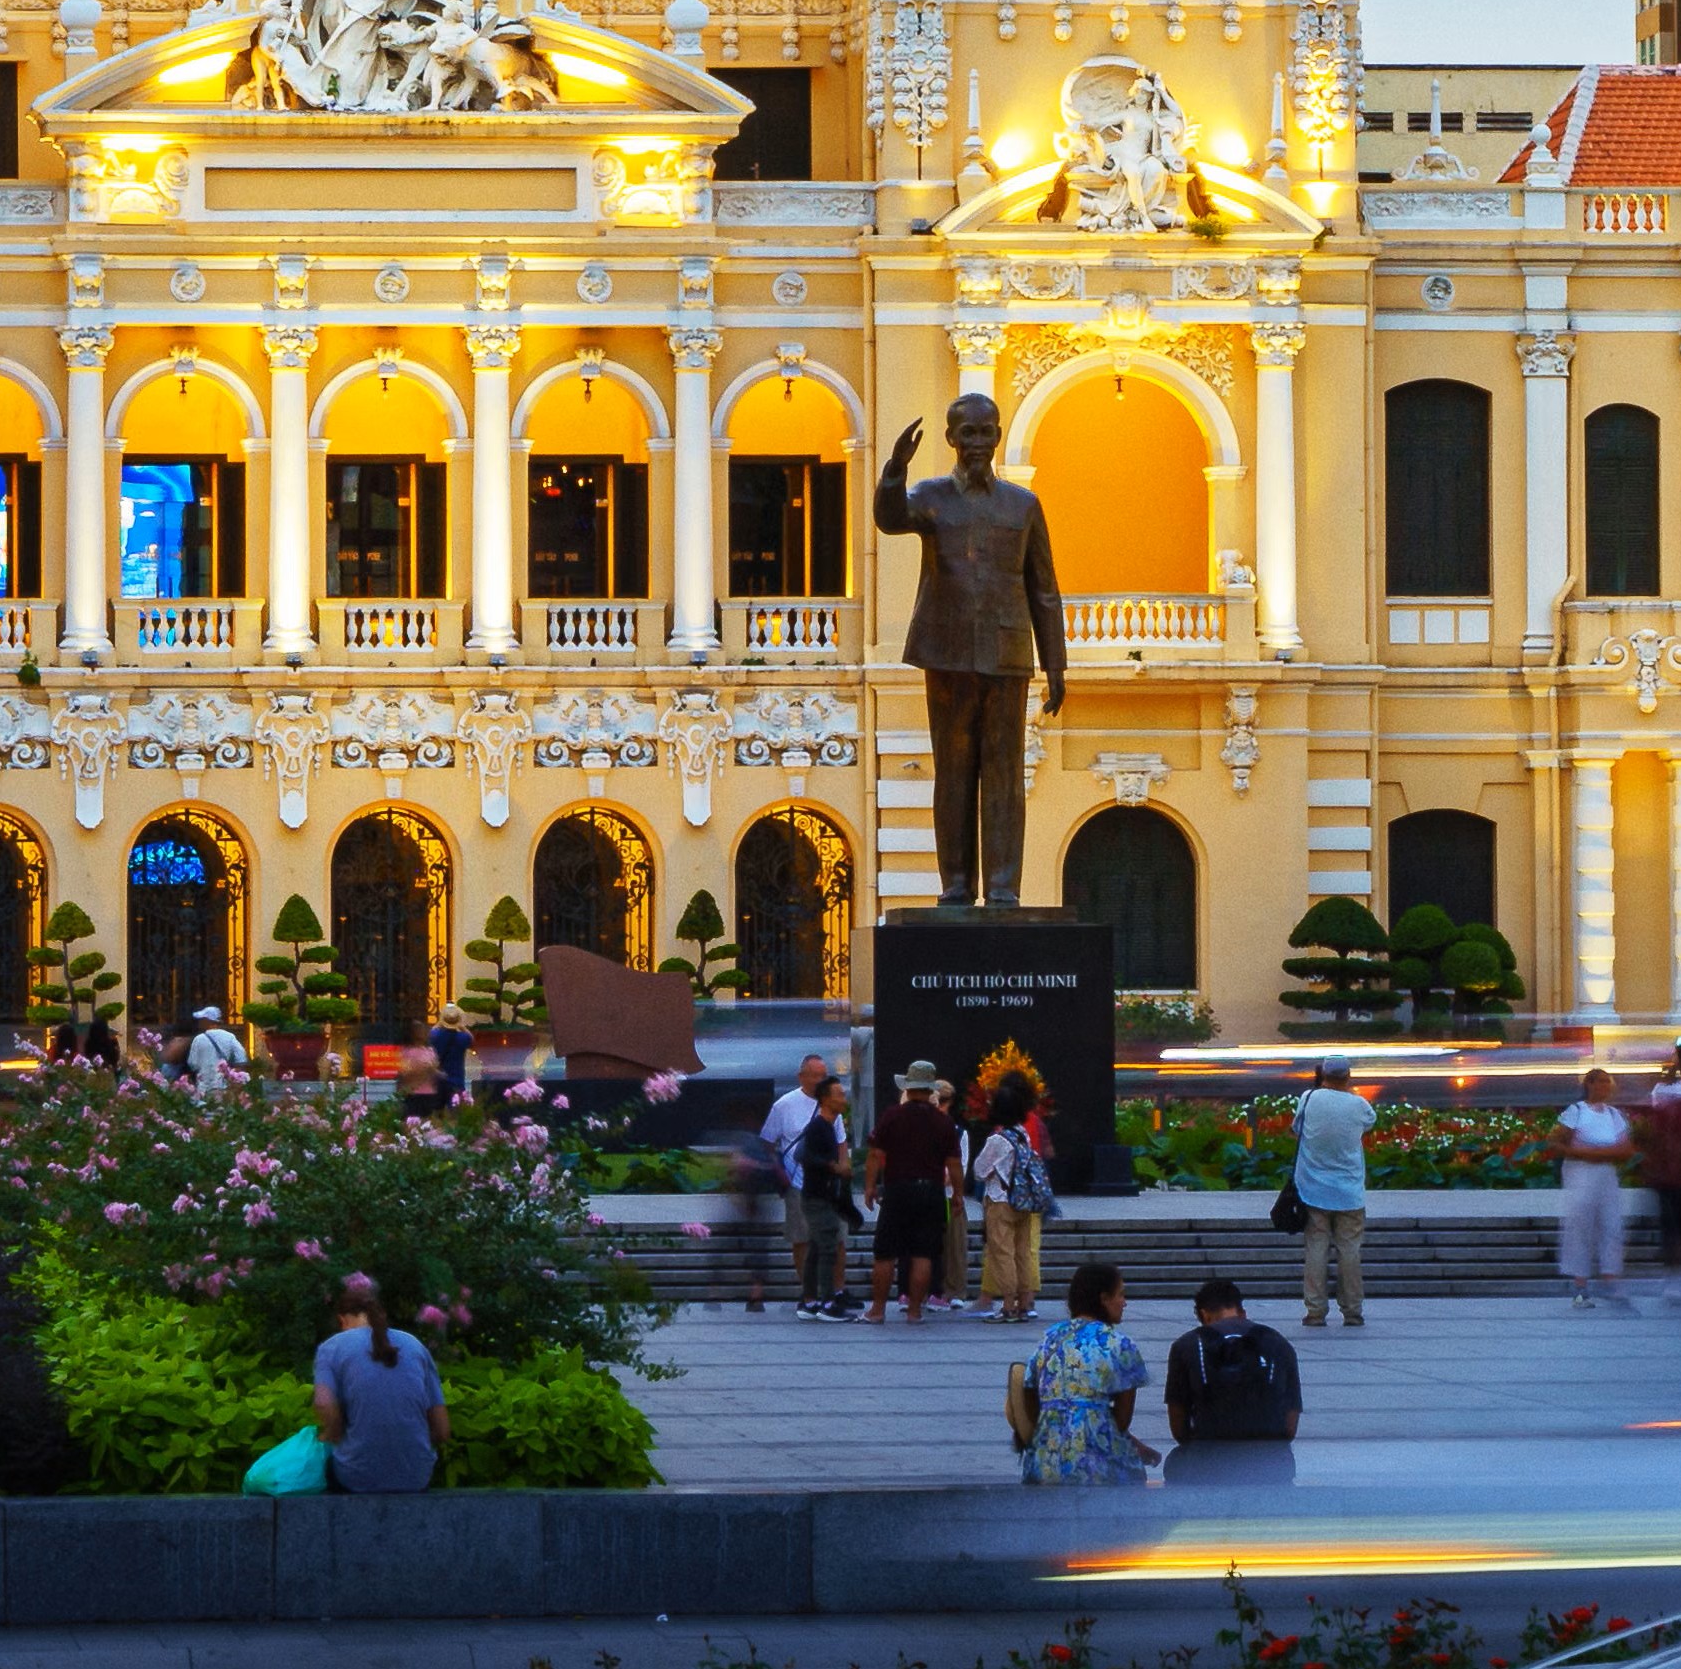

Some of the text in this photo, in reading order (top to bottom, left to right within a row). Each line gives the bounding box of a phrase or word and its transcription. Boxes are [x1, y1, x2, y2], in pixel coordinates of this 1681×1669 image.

[946, 975, 981, 990] TỊCH
[1007, 972, 1034, 989] CHÍ
[1036, 974, 1079, 989] MINH
[955, 996, 990, 1008] (1890
[1000, 996, 1034, 1008] 1969)
